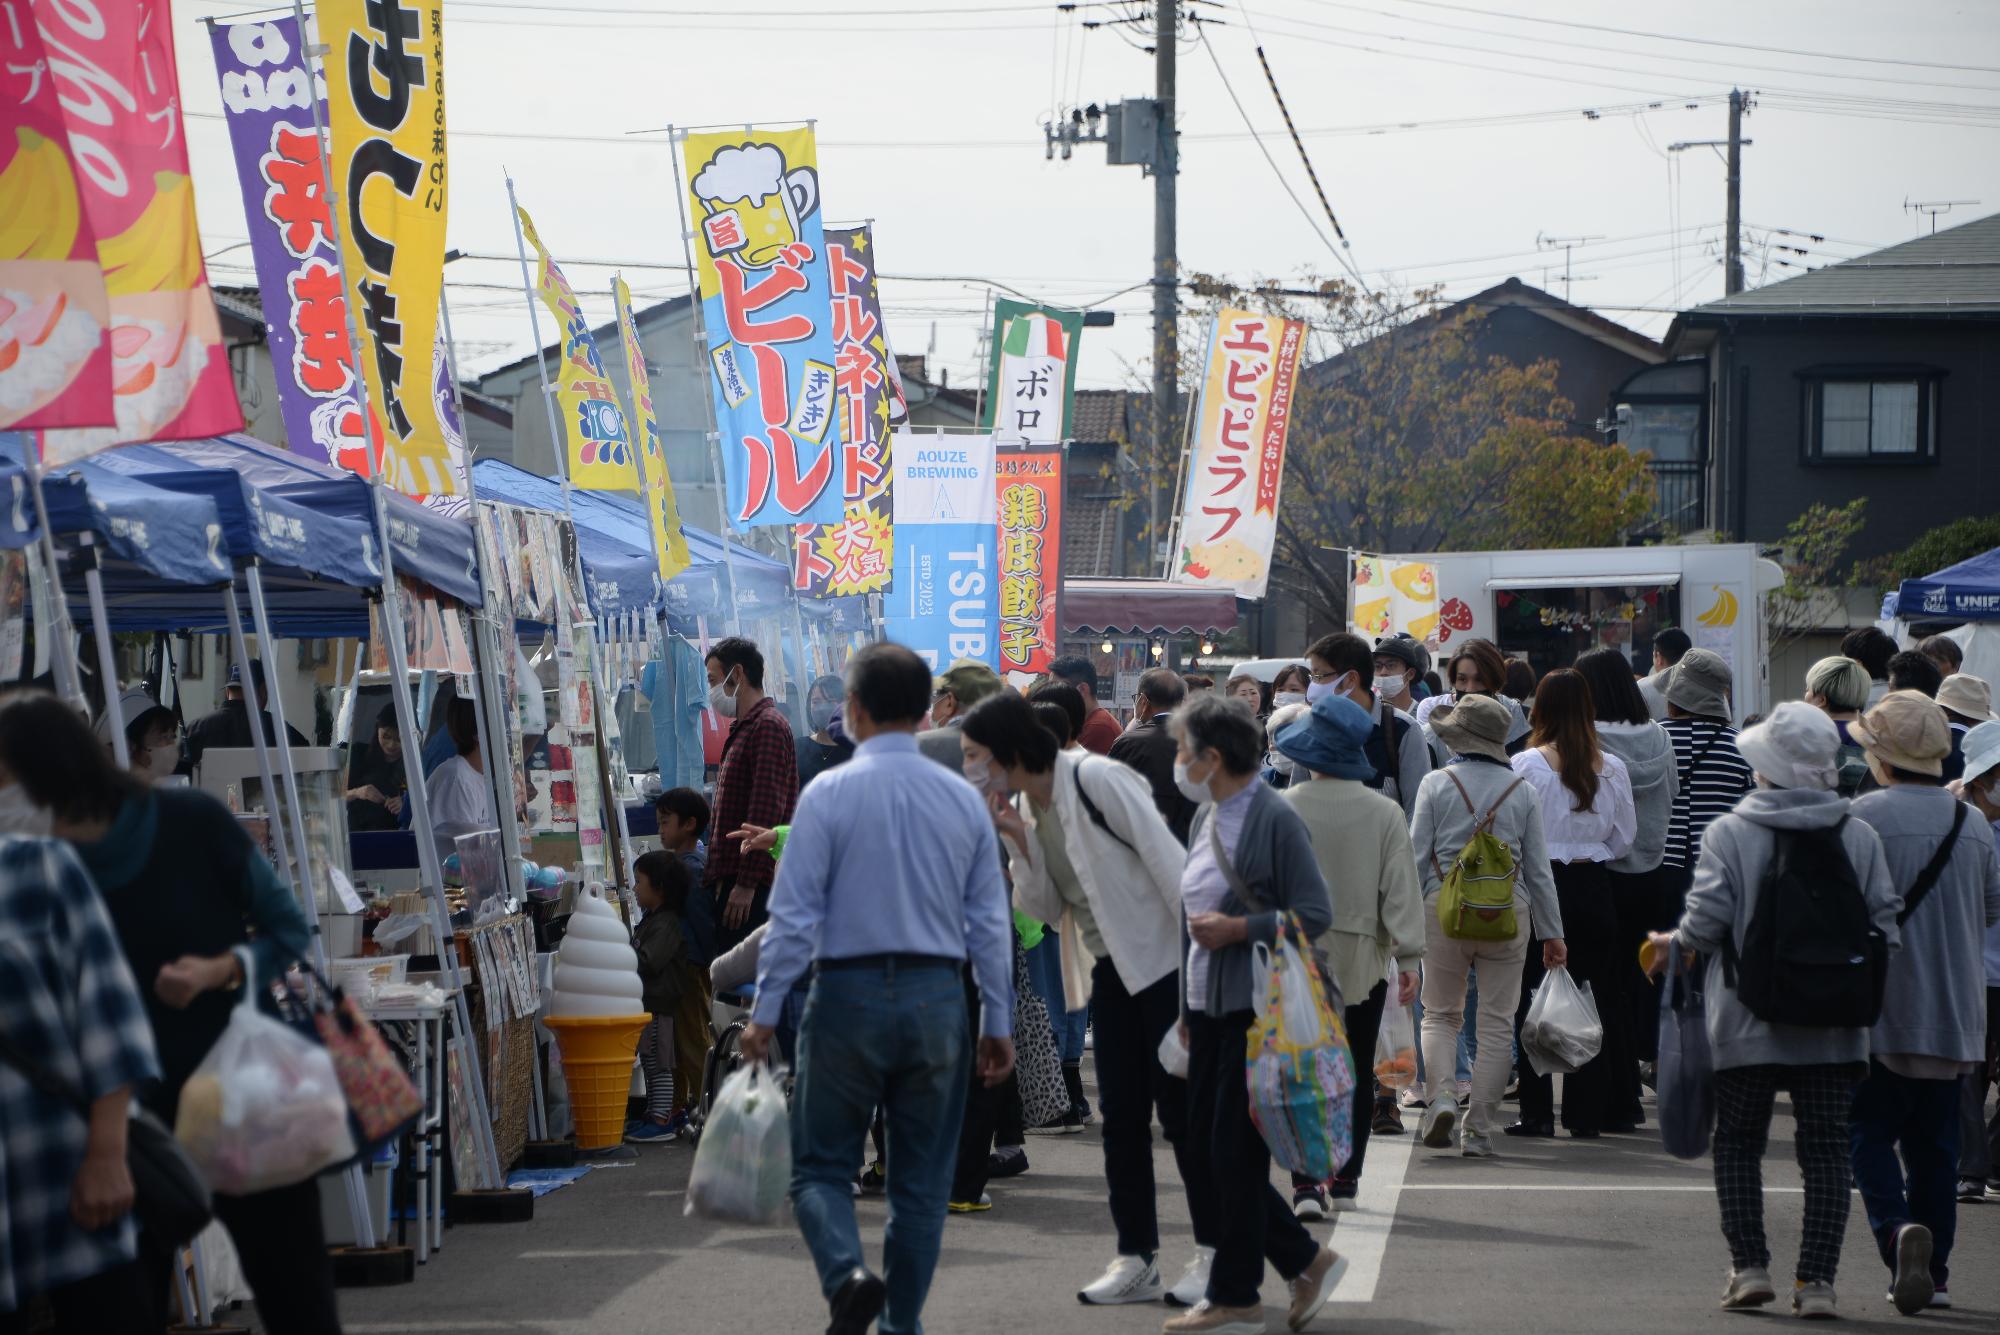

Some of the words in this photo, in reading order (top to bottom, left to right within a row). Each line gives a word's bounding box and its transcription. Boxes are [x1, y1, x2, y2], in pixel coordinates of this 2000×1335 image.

[708, 215, 741, 249] 旨
[714, 239, 832, 522] ビール
[798, 369, 830, 433] キンキン
[827, 243, 882, 497] トルネード
[1260, 325, 1300, 500] 素材にこだわったおいしい
[906, 466, 979, 479] BREWING
[916, 450, 969, 463] AOUZE
[1201, 321, 1270, 543] エビピラフ
[919, 554, 932, 580] ESTD
[919, 581, 934, 616] 2023
[947, 543, 986, 667] TSUB
[1000, 484, 1044, 665] 鶏皮餃子
